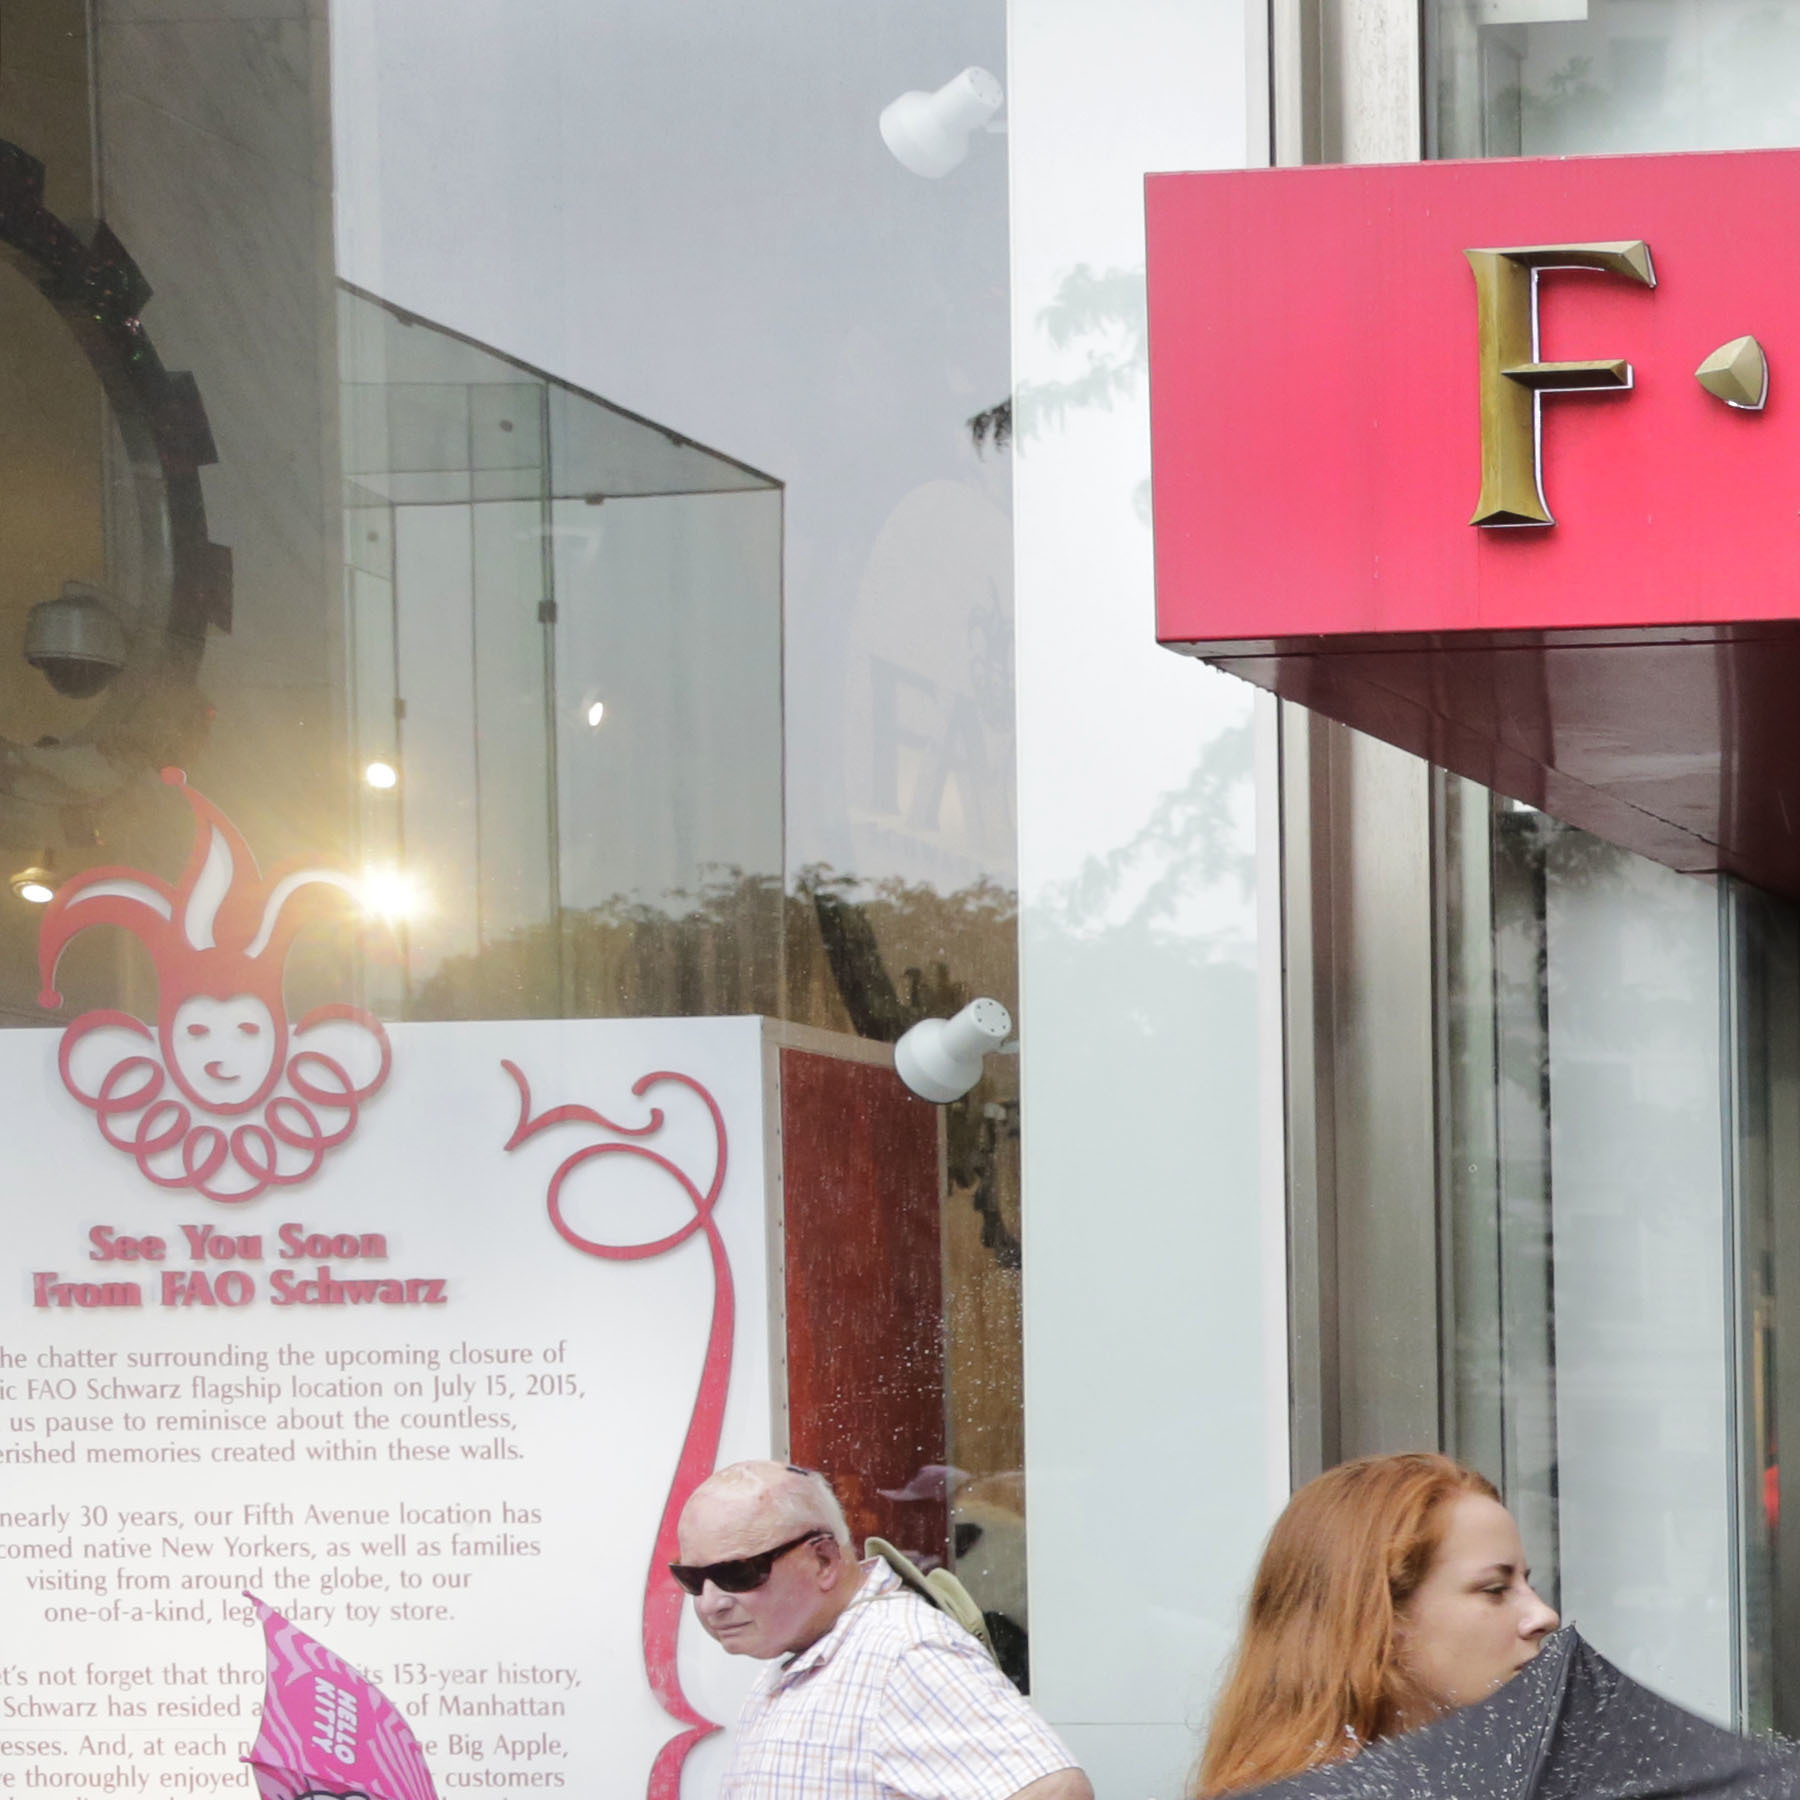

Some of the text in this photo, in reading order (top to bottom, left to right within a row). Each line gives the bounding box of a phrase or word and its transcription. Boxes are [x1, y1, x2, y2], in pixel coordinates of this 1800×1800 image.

[89, 1222, 387, 1261] See You Soon
[32, 1266, 448, 1308] From FAO Schwarz
[37, 1346, 118, 1368] chatter
[127, 1344, 269, 1371] surrounding
[278, 1344, 314, 1366] the
[325, 1344, 440, 1370] upcoming
[449, 1341, 533, 1364] closure
[543, 1340, 567, 1363] of
[27, 1378, 76, 1400] FAO
[87, 1377, 181, 1399] Schwarz
[192, 1376, 281, 1404] flagship
[291, 1375, 383, 1398] location
[394, 1381, 423, 1397] on
[432, 1374, 476, 1403] July
[487, 1374, 515, 1399] 15,
[526, 1373, 585, 1399] 2015,
[10, 1405, 517, 1437] us pause to reminisce about the countless,
[87, 1441, 201, 1463] memories
[211, 1439, 296, 1462] created
[306, 1438, 377, 1461] within
[388, 1438, 450, 1461] these
[460, 1437, 525, 1460] walls.
[0, 1500, 542, 1533] nearly 30 years, our Fifth Avenue location has
[84, 1537, 152, 1558] native
[162, 1537, 214, 1557] New
[224, 1535, 317, 1560] Yorkers,
[326, 1541, 351, 1557] as
[361, 1534, 407, 1556] well
[416, 1541, 441, 1556] as
[451, 1533, 542, 1556] families
[26, 1566, 472, 1596] visiting from around the globe, to our
[44, 1599, 213, 1625] one-of-a-kind,
[346, 1602, 380, 1627] toy
[390, 1601, 455, 1621] store.
[38, 1665, 77, 1685] not
[86, 1663, 153, 1691] forget
[162, 1663, 209, 1685] that
[394, 1663, 487, 1690] 153-year
[498, 1662, 580, 1690] history,
[5, 1696, 97, 1717] Schwarz
[108, 1695, 147, 1716] has
[157, 1695, 240, 1716] resided
[406, 1694, 565, 1716] of Manhattan
[312, 1676, 358, 1765] HELLO KITTY
[79, 1735, 133, 1758] And,
[143, 1738, 164, 1755] at
[174, 1734, 225, 1755] each
[449, 1735, 483, 1760] Big
[494, 1733, 568, 1760] Apple,
[26, 1766, 149, 1793] thoroughly
[160, 1766, 249, 1793] enjoyed
[445, 1770, 565, 1787] customers
